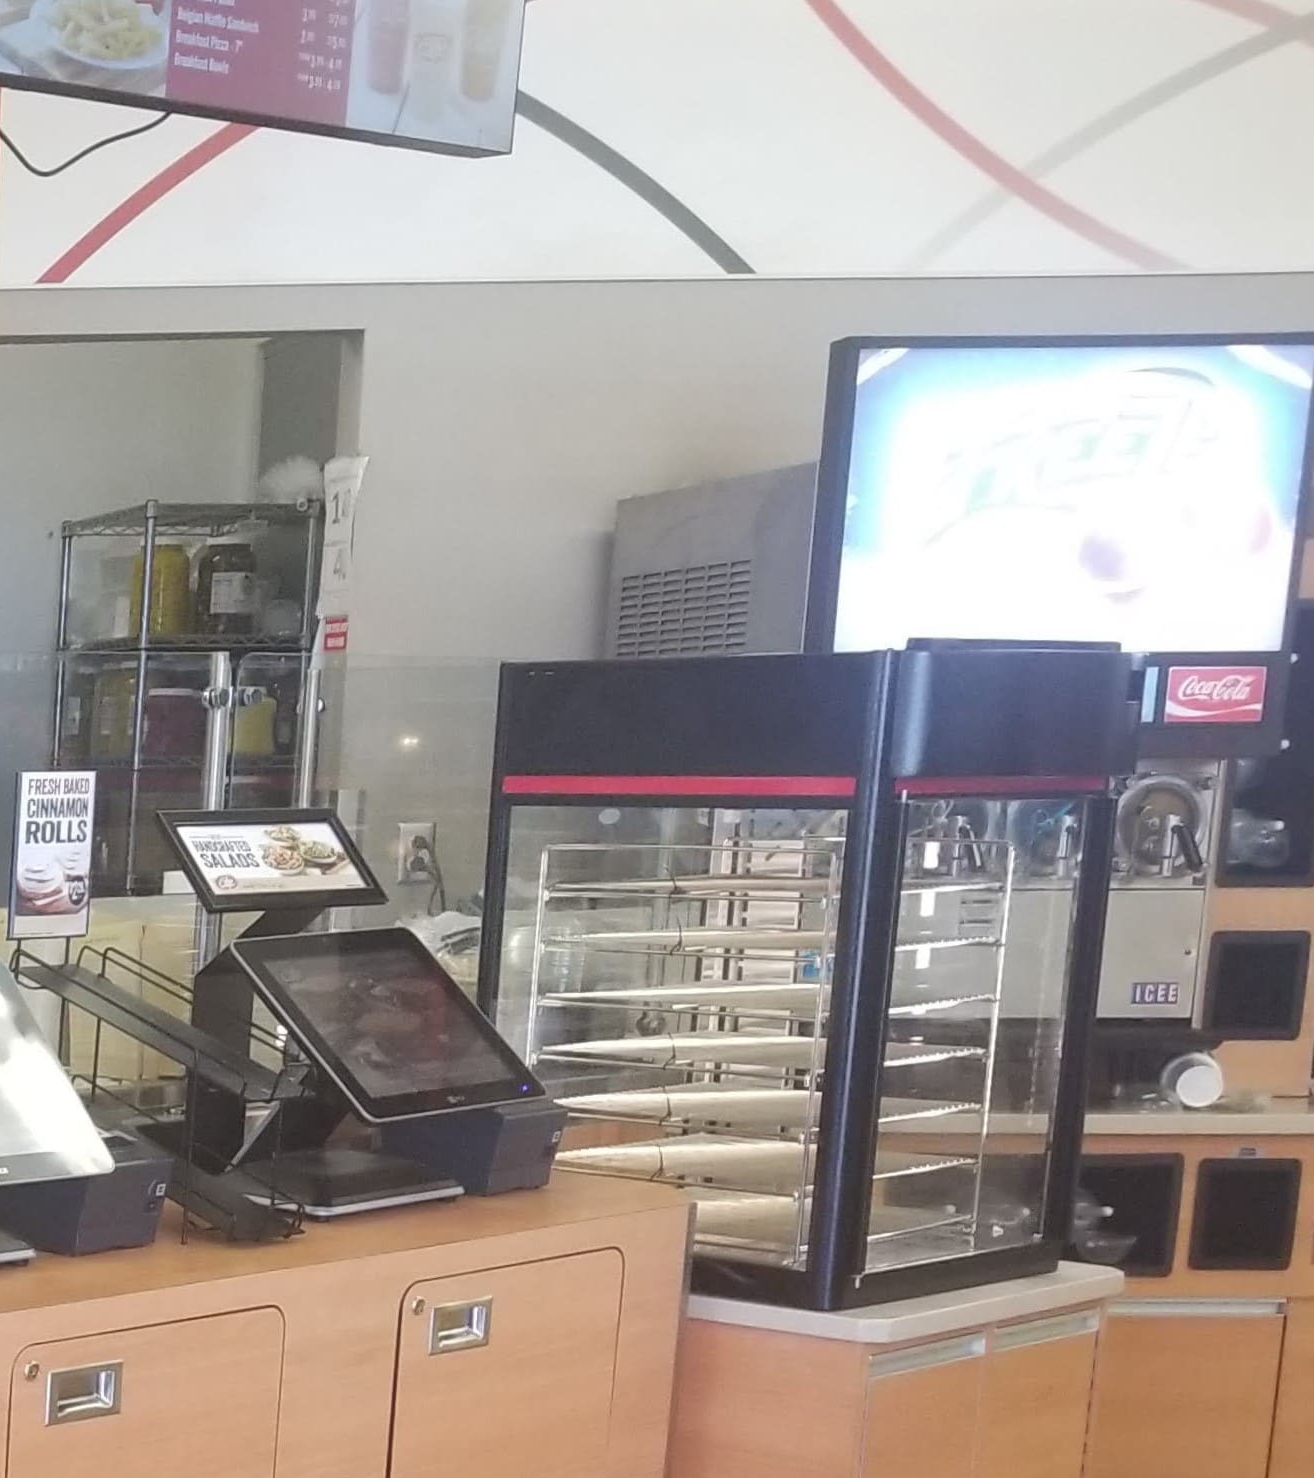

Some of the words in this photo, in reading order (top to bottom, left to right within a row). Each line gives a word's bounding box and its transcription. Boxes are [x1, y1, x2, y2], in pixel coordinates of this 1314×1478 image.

[28, 778, 61, 796] FRESH
[63, 777, 90, 795] BAKED
[27, 797, 88, 819] CINNAMON
[25, 820, 87, 844] ROLLS
[201, 853, 260, 869] SALADS
[1135, 984, 1177, 1002] ICEE
